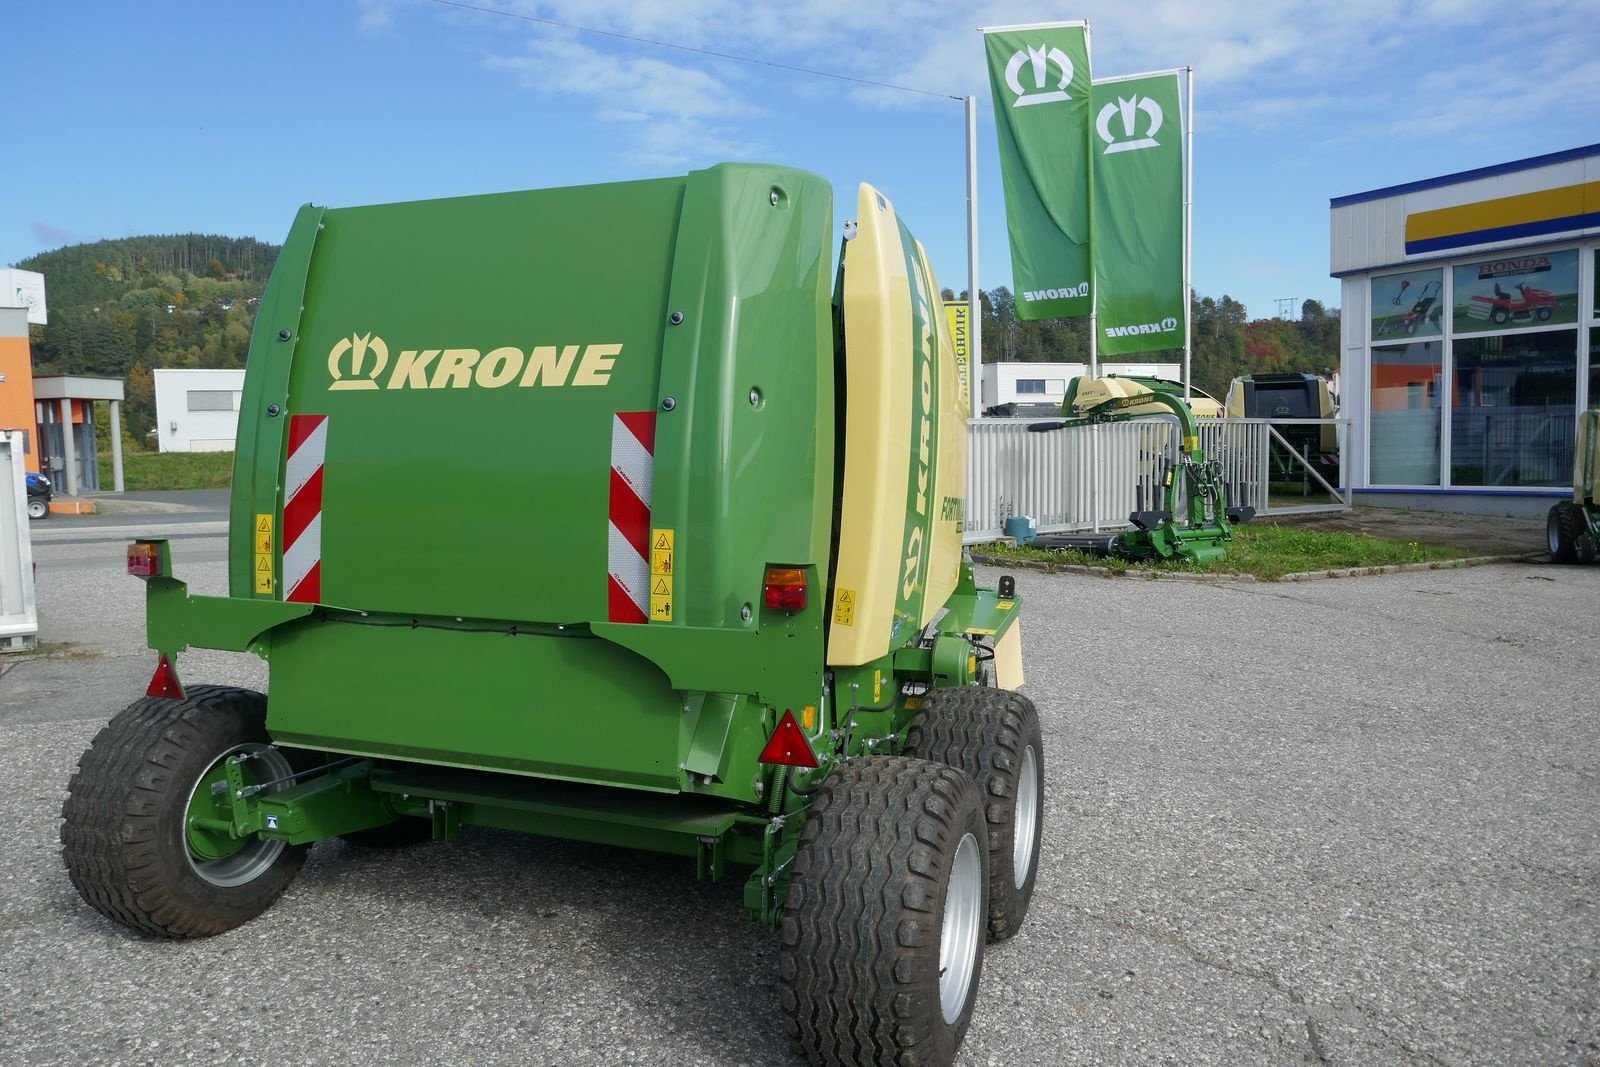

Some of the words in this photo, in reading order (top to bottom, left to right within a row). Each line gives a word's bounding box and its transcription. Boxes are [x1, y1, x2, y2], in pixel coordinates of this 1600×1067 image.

[1478, 256, 1552, 273] HONDA
[387, 344, 623, 389] KRONE
[911, 255, 931, 516] KRONE
[1129, 395, 1154, 405] KRONE
